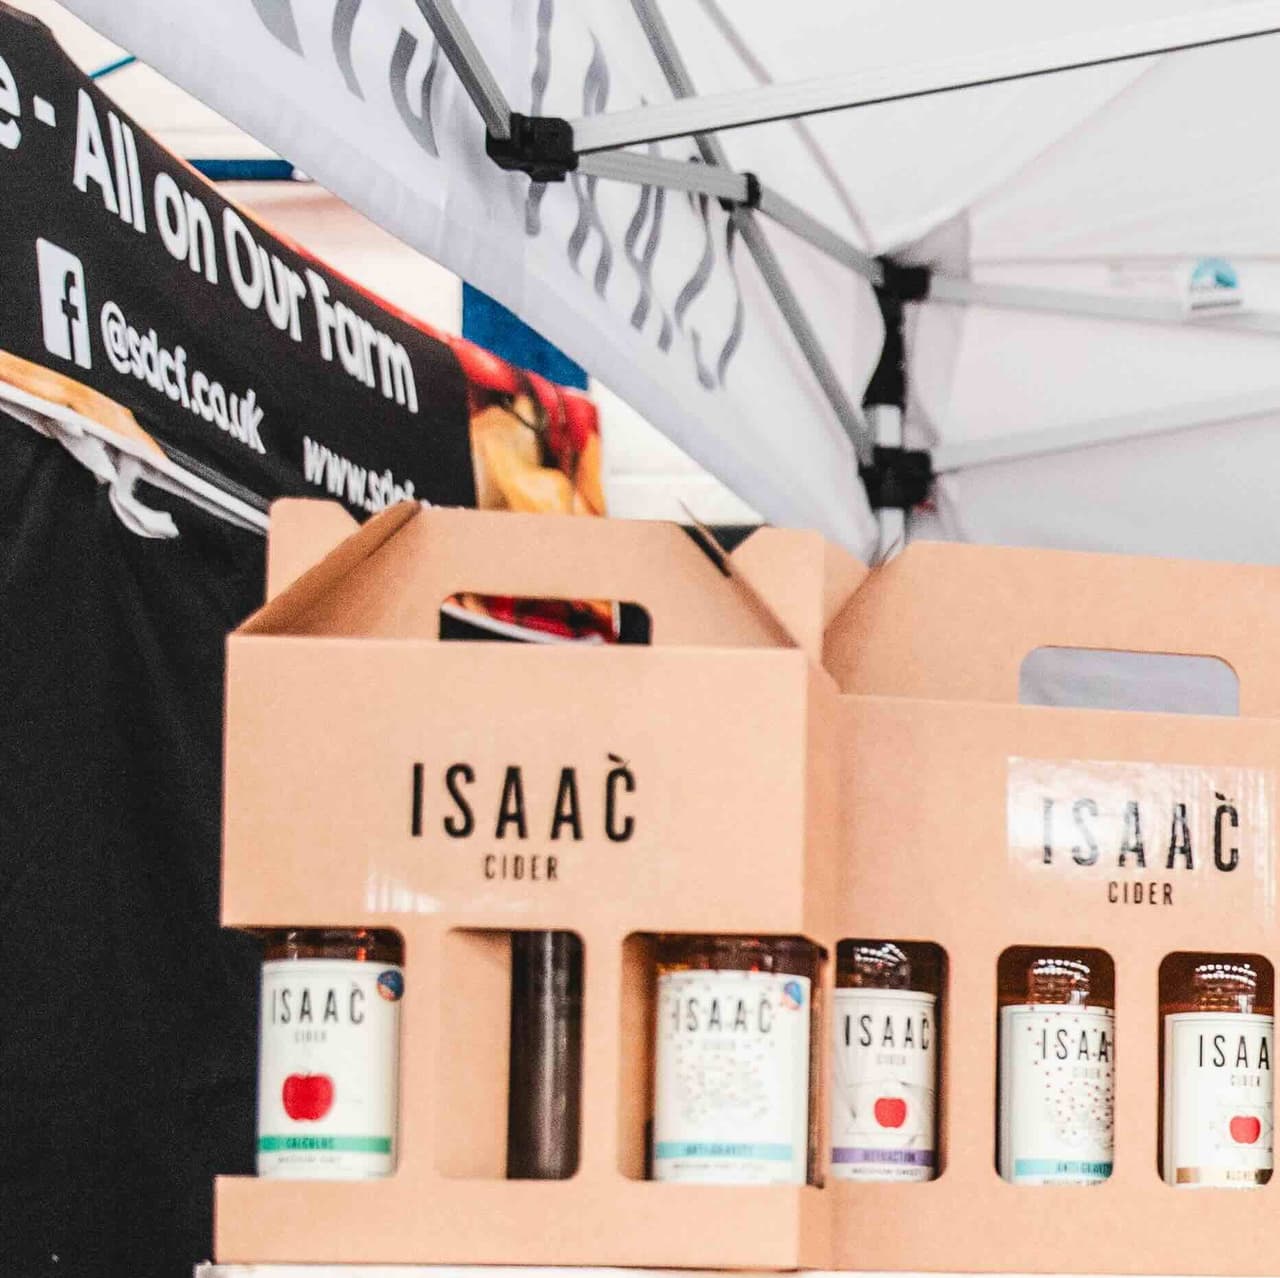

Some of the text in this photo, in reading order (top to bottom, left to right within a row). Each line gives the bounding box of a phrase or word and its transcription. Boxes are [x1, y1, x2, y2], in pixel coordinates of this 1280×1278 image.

[73, 87, 146, 233] All
[154, 172, 218, 284] on
[222, 207, 305, 341] Our
[305, 269, 419, 414] Farm
[100, 300, 266, 455] @sdcf.co.uk
[484, 854, 559, 880] CIDER
[1108, 881, 1174, 906] CIDER
[1042, 1028, 1110, 1063] ISAA
[1199, 1034, 1271, 1071] ISAA
